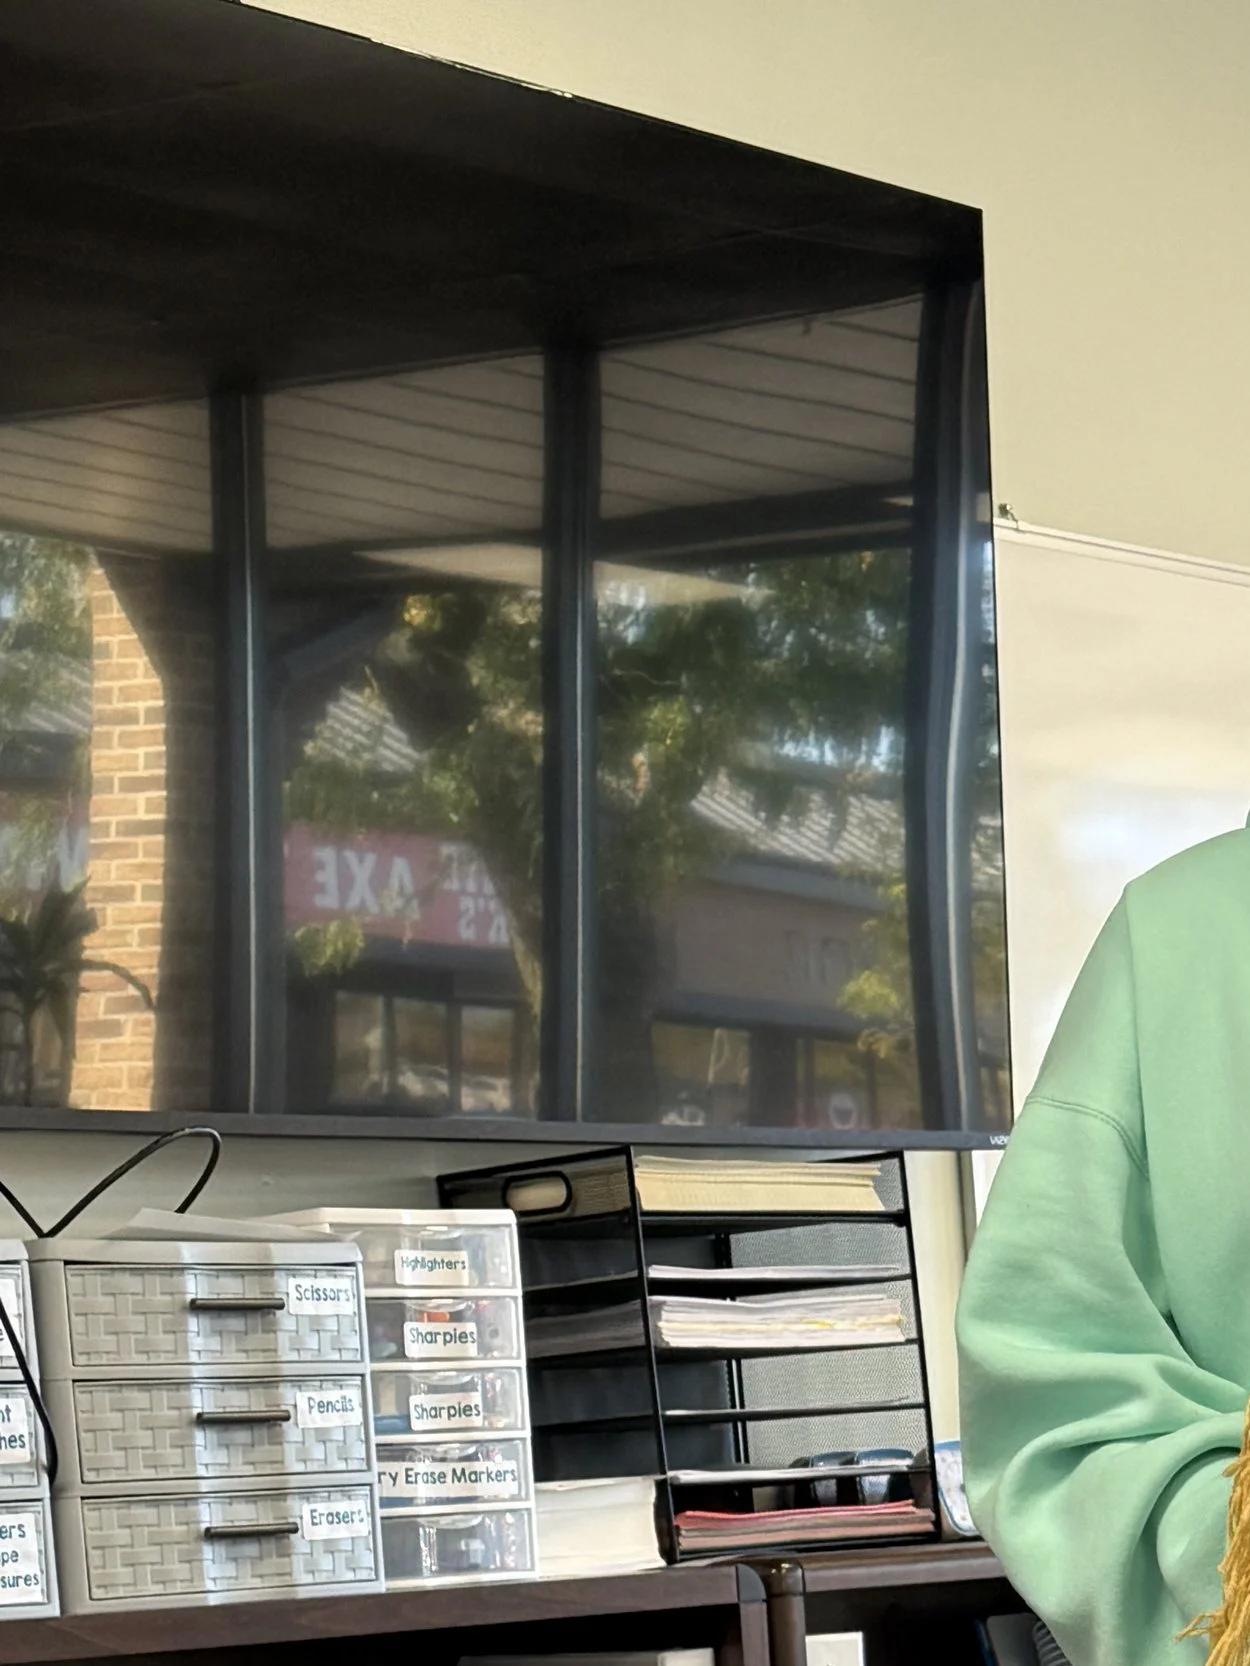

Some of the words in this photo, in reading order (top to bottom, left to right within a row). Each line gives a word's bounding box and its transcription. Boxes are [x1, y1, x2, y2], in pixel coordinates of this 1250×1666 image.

[400, 1255, 467, 1273] Highlighters
[295, 1284, 351, 1302] Scissors
[409, 1327, 477, 1346] Sharpies
[307, 1395, 355, 1414] Pencils
[414, 1400, 481, 1420] Sharpies
[404, 1467, 447, 1485] Erase
[451, 1466, 518, 1484] Markers
[310, 1508, 365, 1526] Erasers
